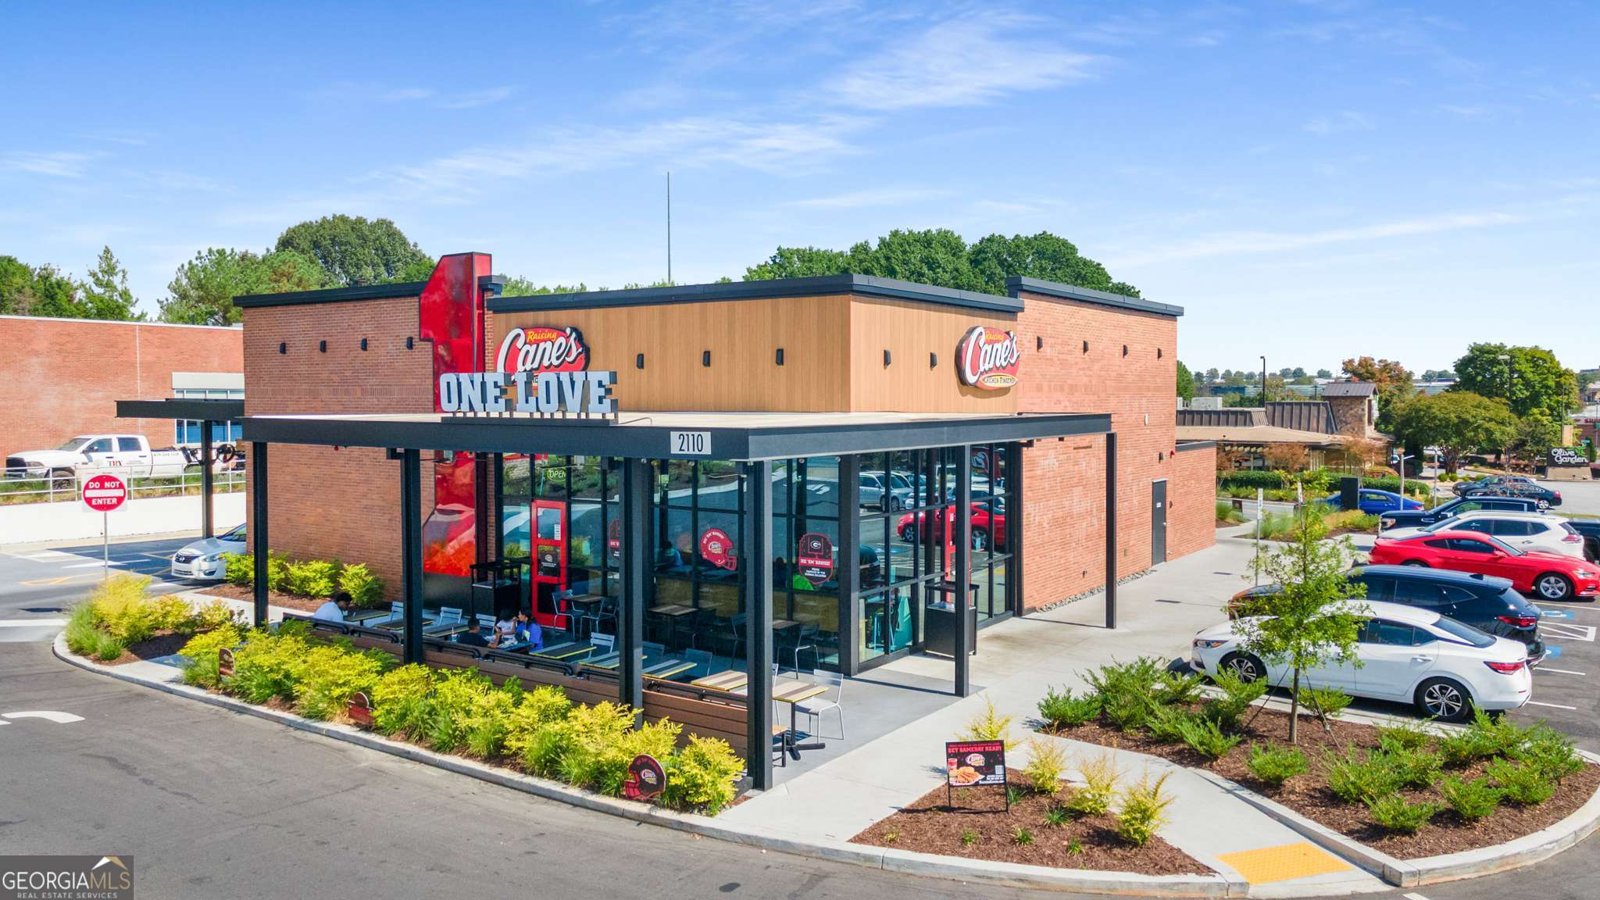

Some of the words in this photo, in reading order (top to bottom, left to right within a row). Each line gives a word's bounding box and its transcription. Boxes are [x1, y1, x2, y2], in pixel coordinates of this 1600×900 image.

[497, 327, 583, 374] Cane's
[965, 326, 1020, 384] Cane's
[440, 371, 509, 413] ONE
[515, 371, 614, 413] LOVE
[678, 433, 704, 453] 2110
[1551, 448, 1575, 457] Olive
[1554, 456, 1588, 464] Garden
[550, 470, 566, 479] OPEN
[88, 481, 101, 489] DO
[91, 497, 118, 505] ENTER
